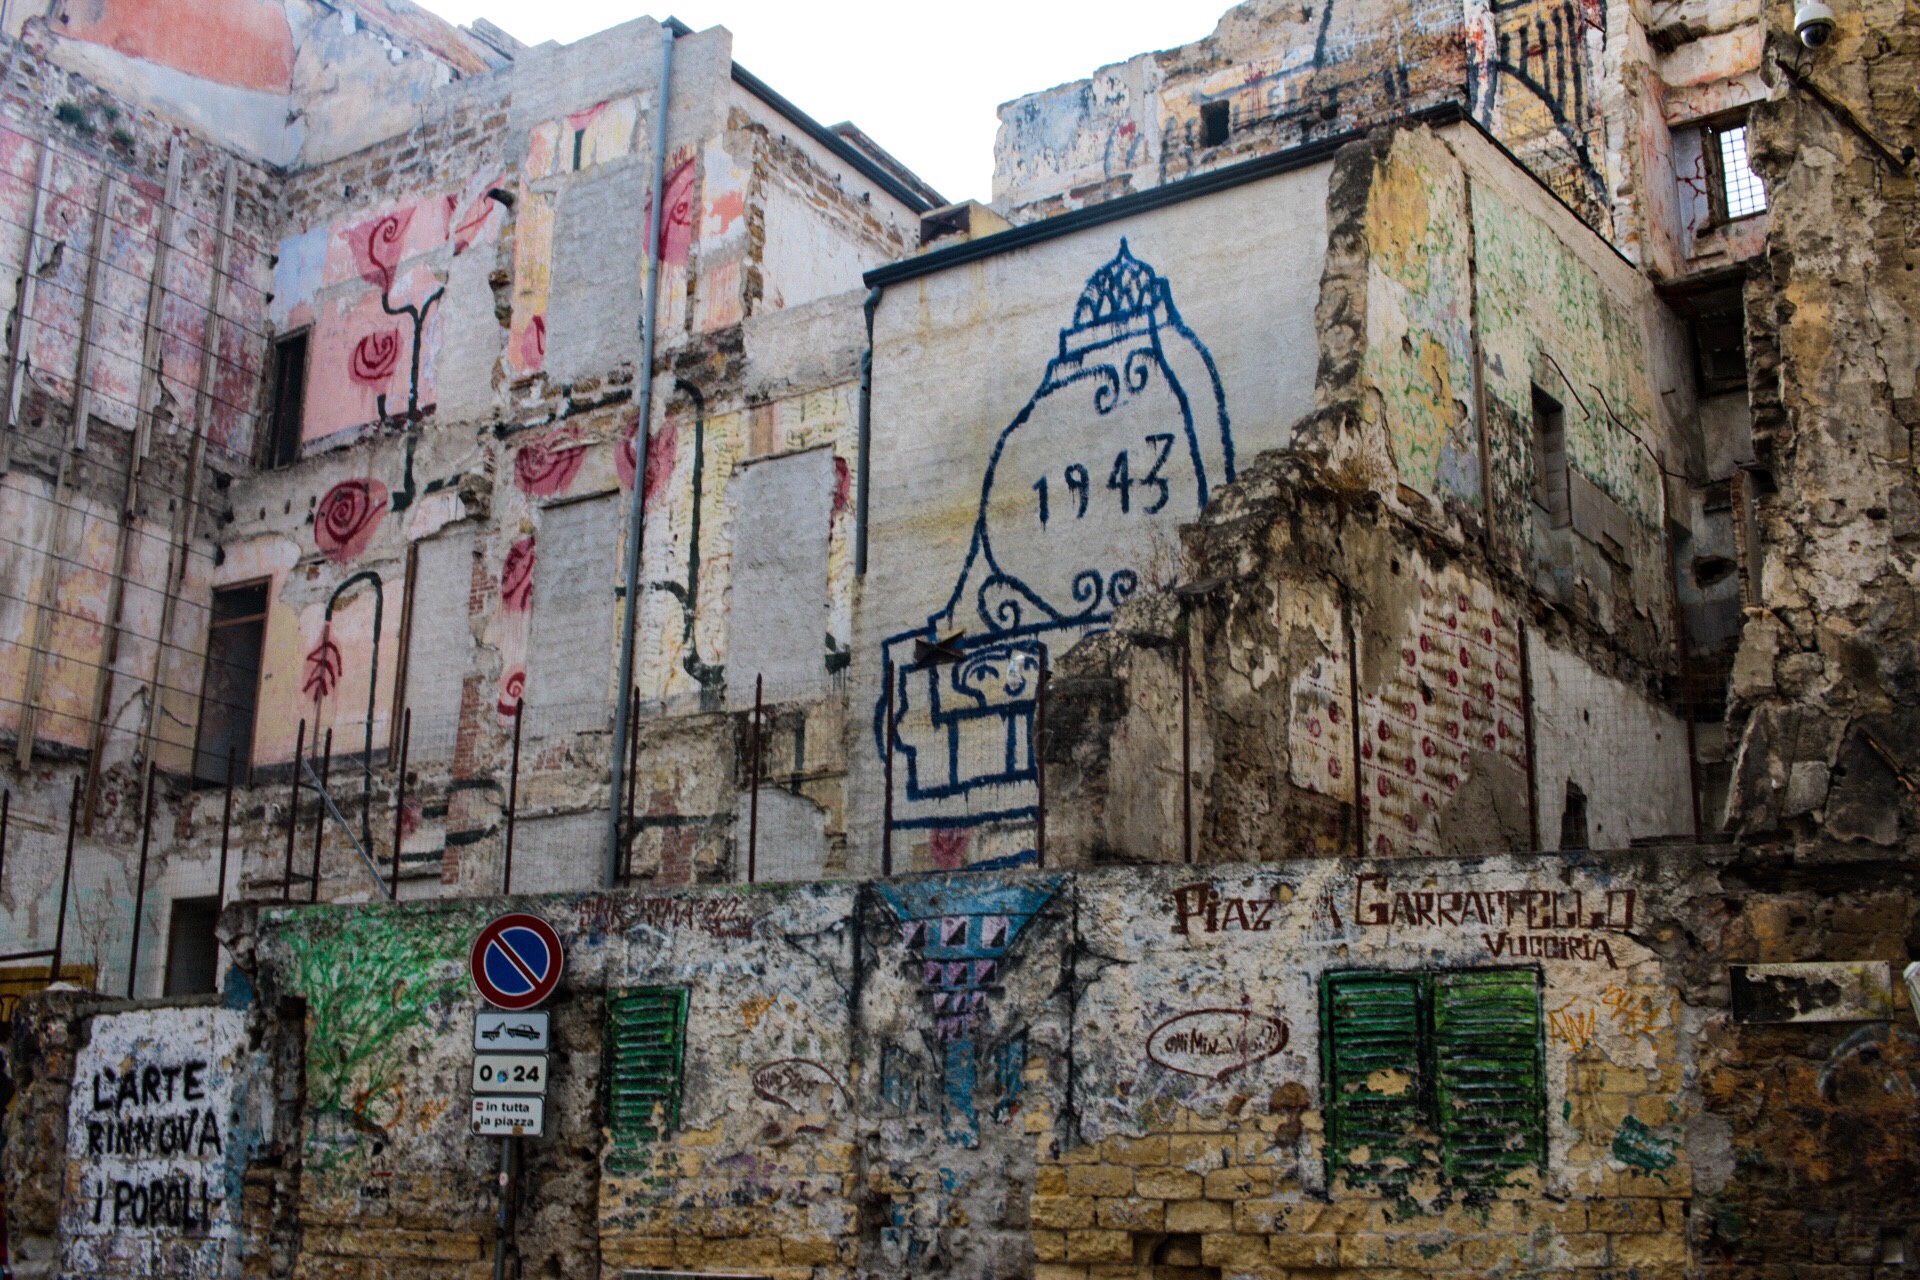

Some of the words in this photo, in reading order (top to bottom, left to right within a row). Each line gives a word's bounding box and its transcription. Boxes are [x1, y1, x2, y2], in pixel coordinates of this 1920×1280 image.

[1032, 433, 1175, 531] 1943
[1355, 873, 1636, 930] GARRAFFELLO
[93, 1058, 207, 1114] L'ARTE
[479, 1064, 493, 1082] 0
[513, 1065, 539, 1082] 24
[88, 1107, 222, 1156] RINNOVA
[480, 1115, 491, 1126] la
[494, 1116, 534, 1128] piazza
[486, 1101, 498, 1112] in
[501, 1102, 530, 1113] tutta
[114, 1174, 212, 1231] POPOLI
